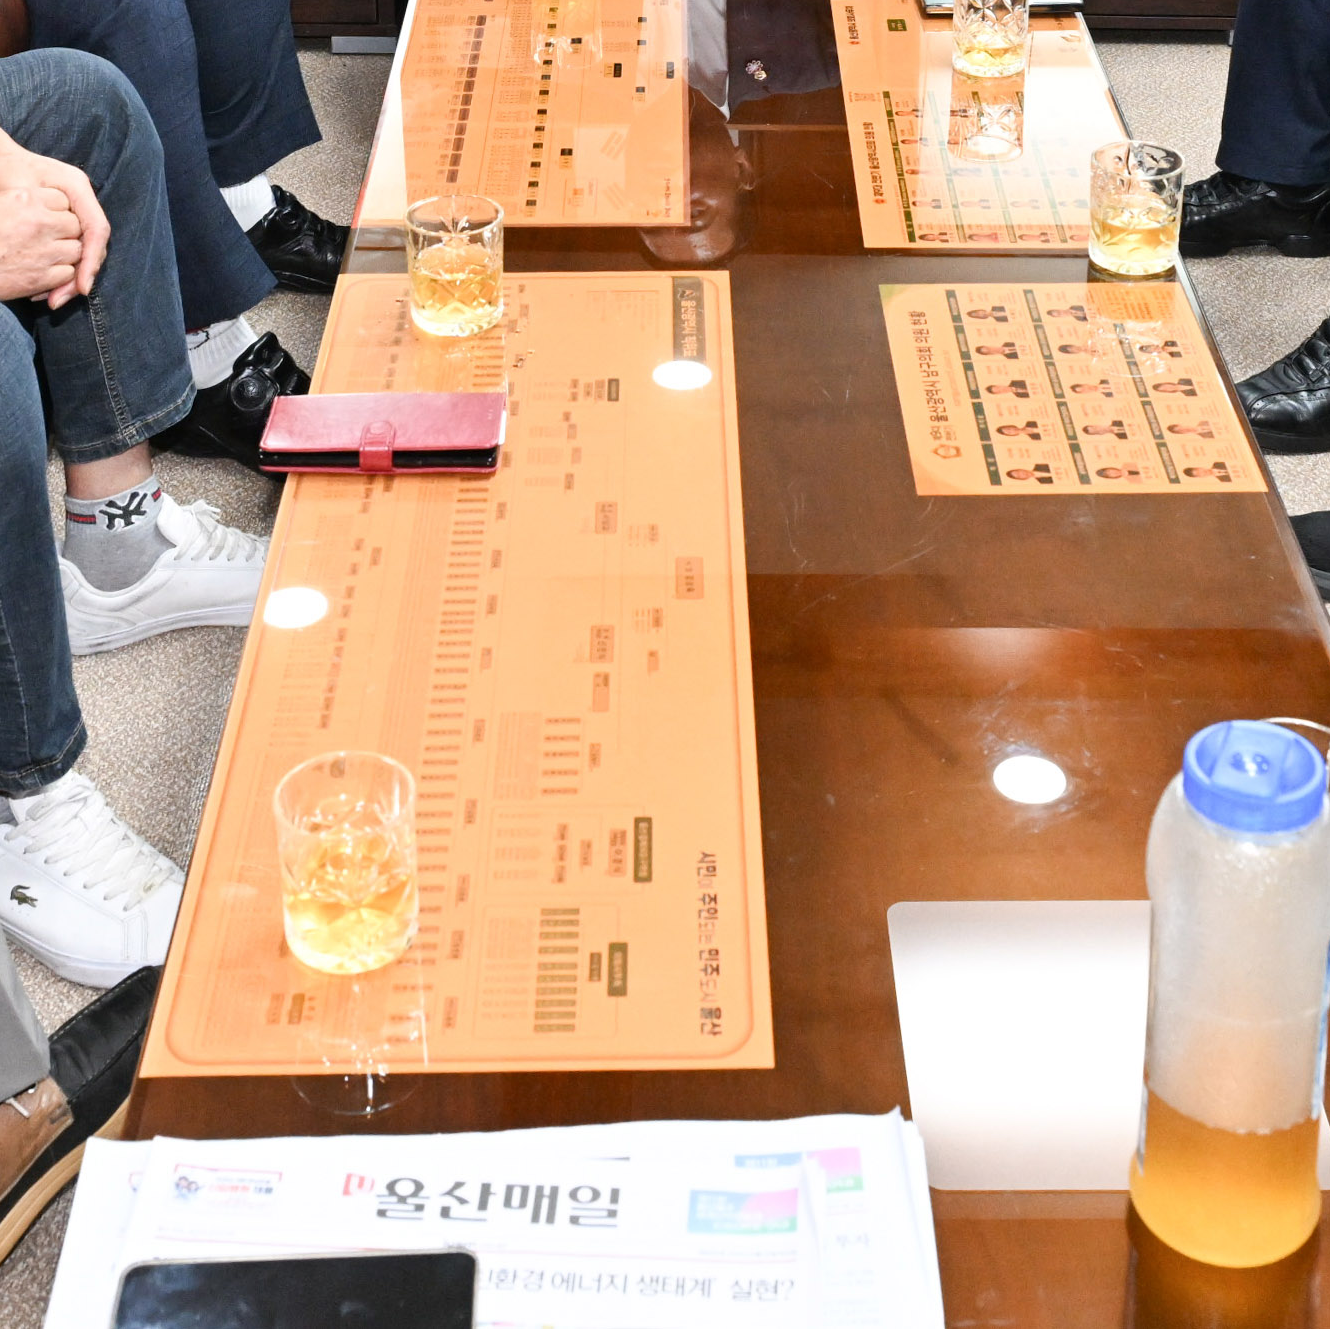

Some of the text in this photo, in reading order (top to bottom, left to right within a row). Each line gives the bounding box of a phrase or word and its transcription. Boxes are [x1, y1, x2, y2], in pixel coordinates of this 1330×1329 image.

[908, 311, 949, 422] 울산광역시 남구의회 의원 현황
[700, 1007, 722, 1036] 울산
[376, 1177, 621, 1228] 울산매일
